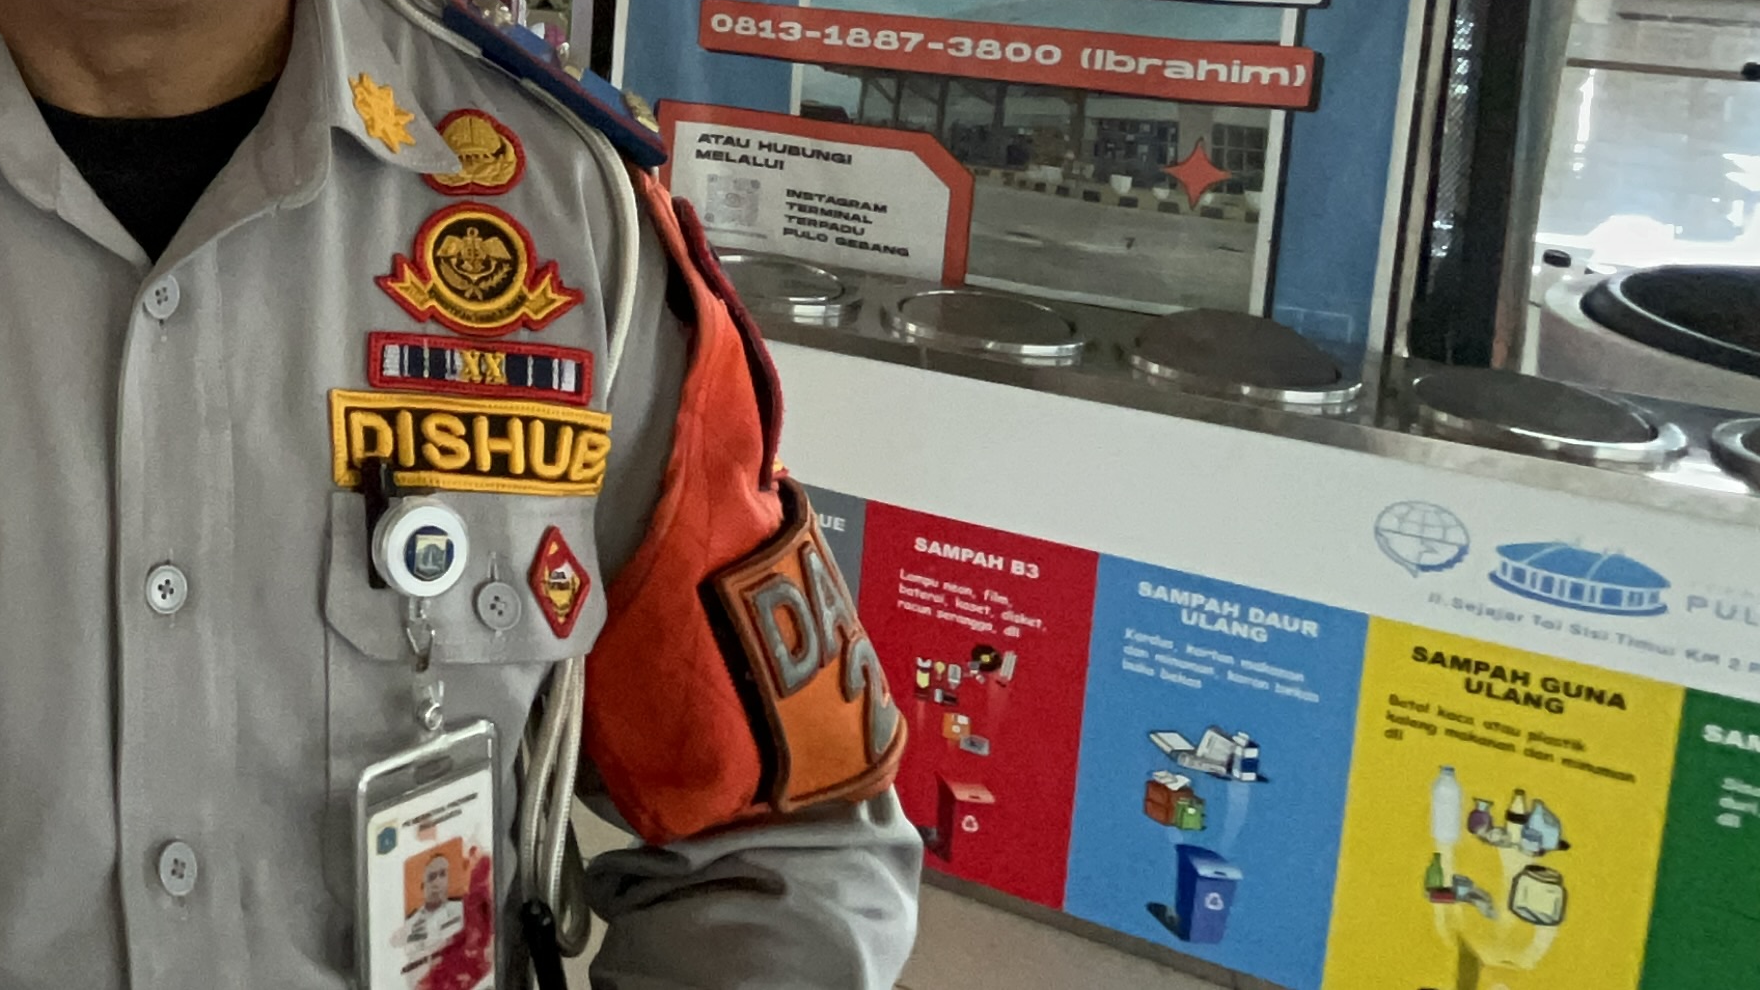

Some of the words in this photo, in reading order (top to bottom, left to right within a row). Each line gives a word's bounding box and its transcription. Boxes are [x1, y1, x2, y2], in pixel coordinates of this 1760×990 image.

[710, 13, 1062, 65] 0813-1887-3800
[1081, 48, 1306, 87] (Ibrahim)
[695, 149, 785, 170] MELALUI
[697, 133, 750, 149] ATAU
[758, 140, 853, 165] HUBUNGI
[785, 202, 873, 224] TERMINAL
[786, 189, 888, 214] INSTAGRAM
[784, 214, 866, 236] TERPADU
[782, 227, 829, 243] PULO
[835, 237, 910, 257] GEBANG
[349, 410, 612, 482] DISHUB
[819, 513, 846, 532] UE
[914, 537, 1004, 571] SAMPAH
[1010, 560, 1039, 579] B3
[1138, 581, 1240, 618] SAMPAH
[1248, 607, 1320, 638] DAUR
[1181, 608, 1268, 643] ULANG
[1686, 594, 1759, 627] PUL
[1411, 646, 1531, 687] SAMPAH
[1540, 676, 1627, 711] GUNA
[1464, 677, 1565, 715] ULANG
